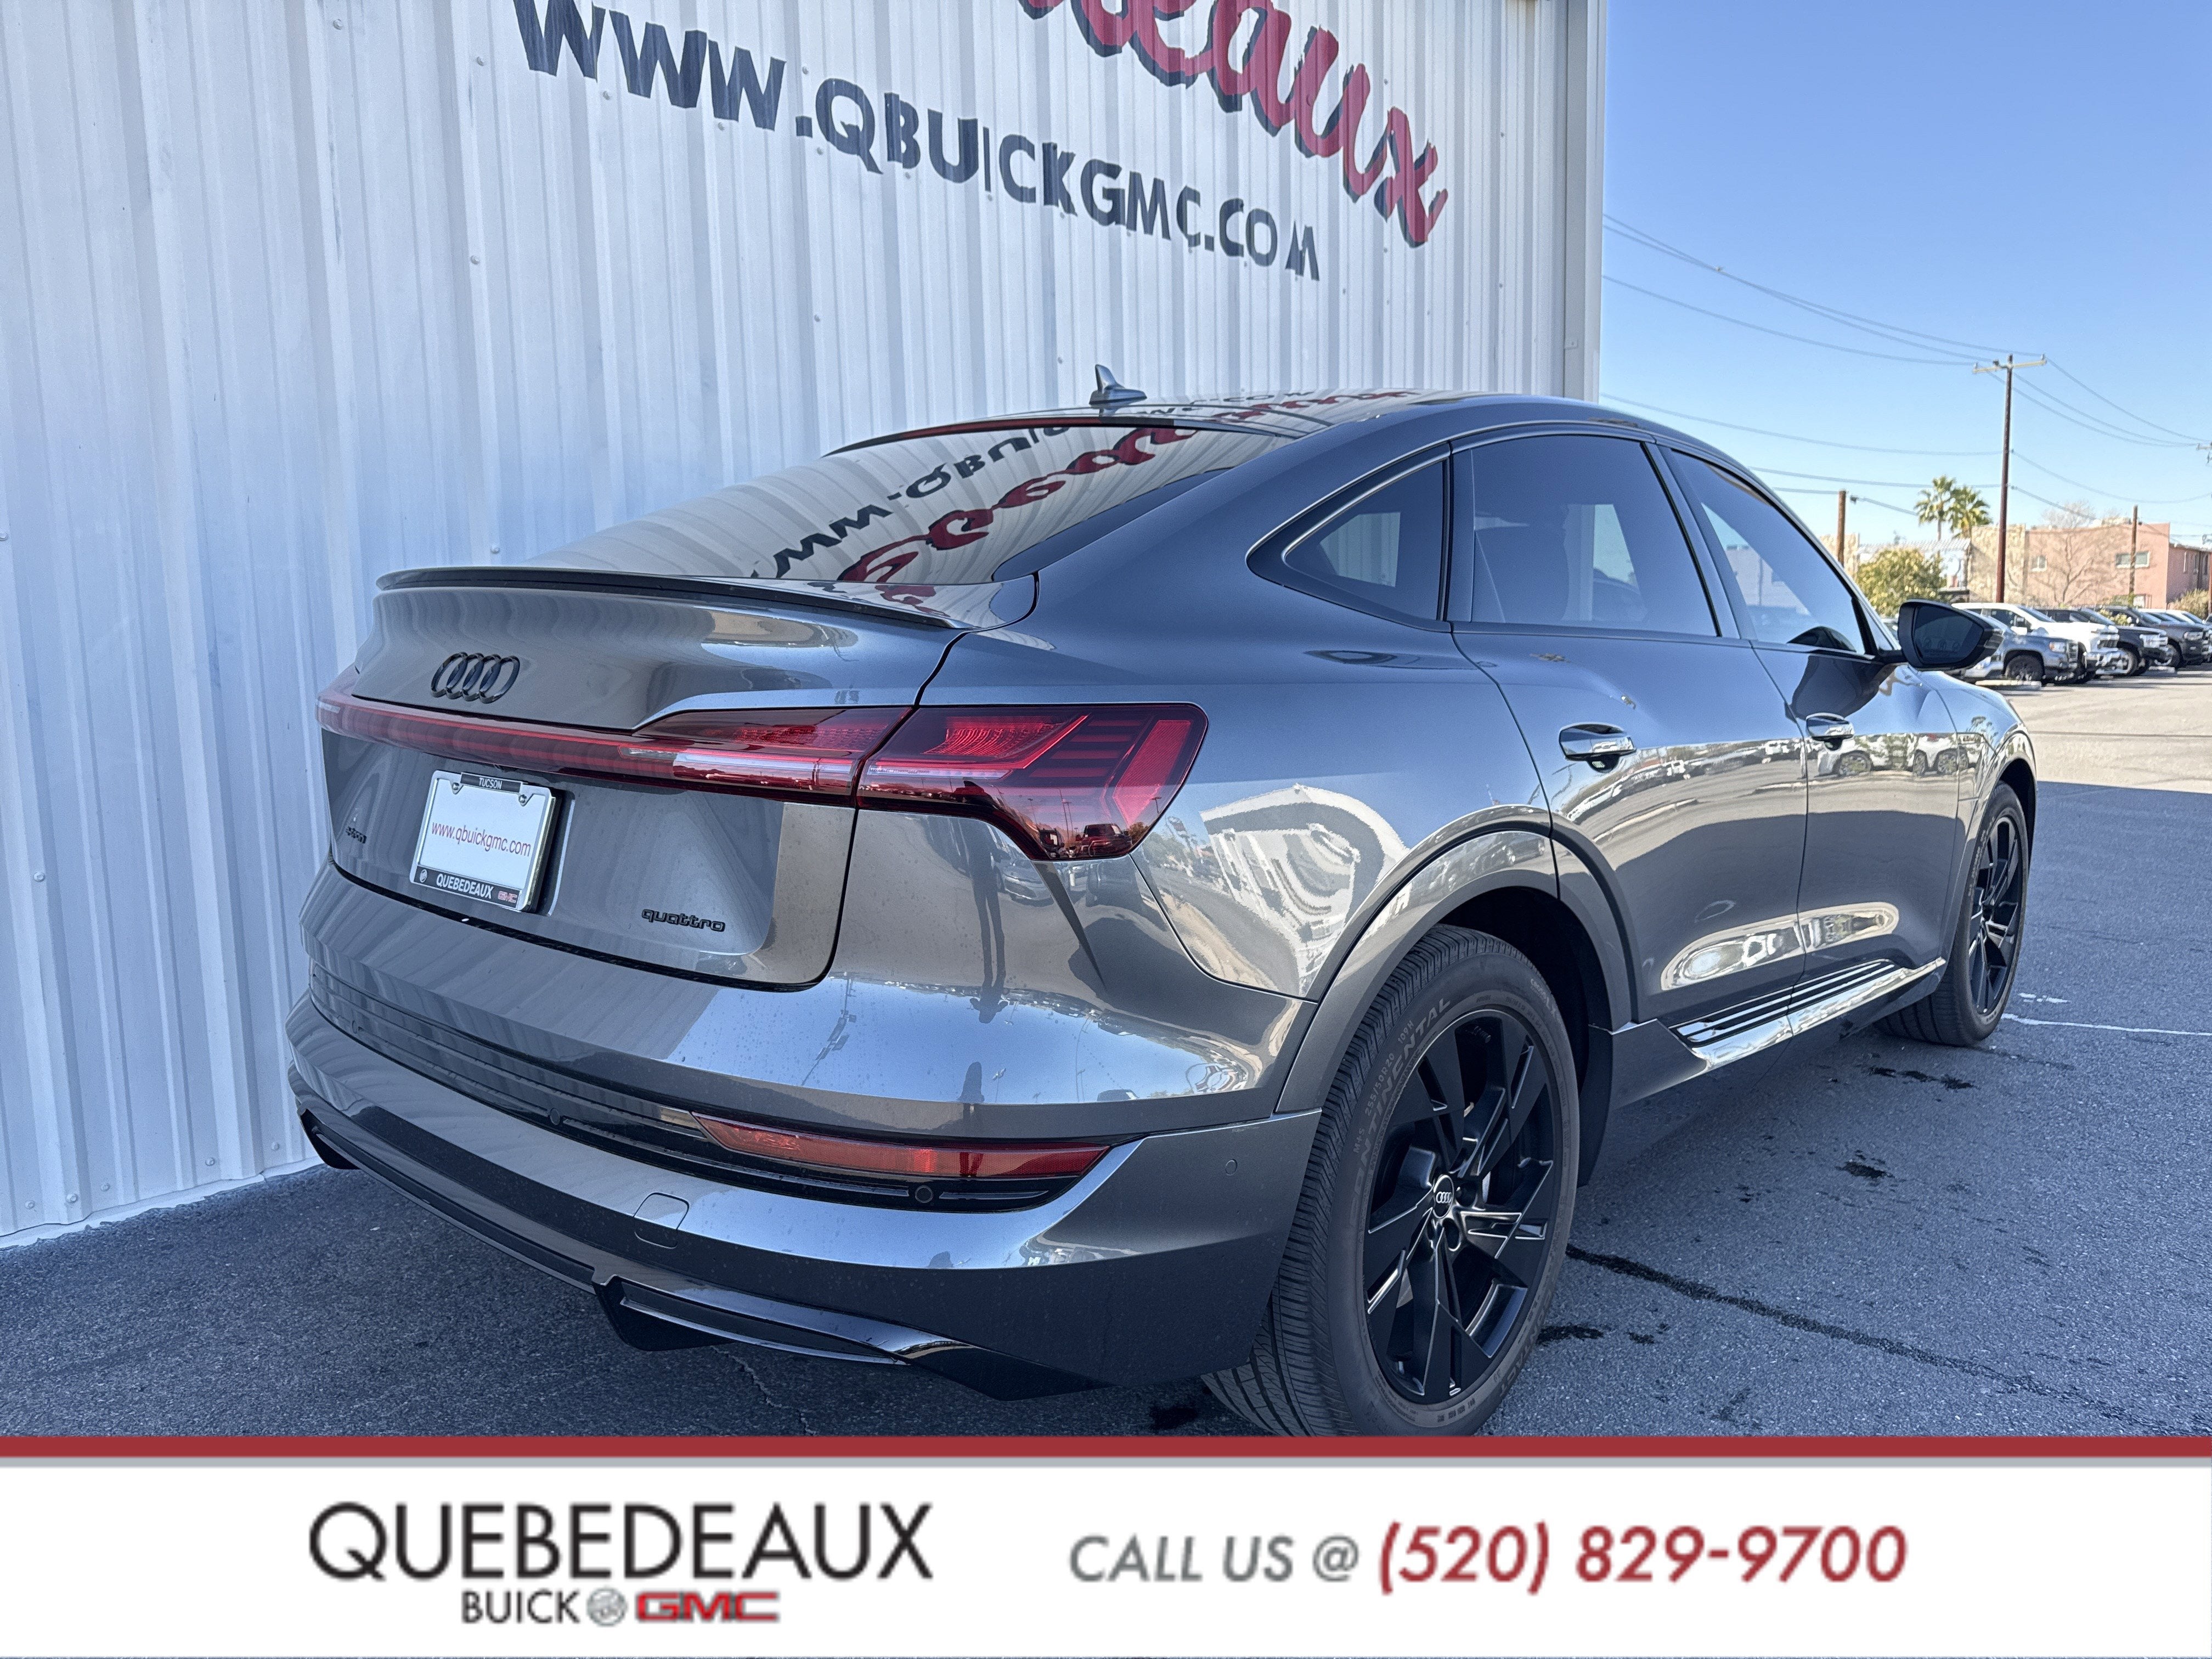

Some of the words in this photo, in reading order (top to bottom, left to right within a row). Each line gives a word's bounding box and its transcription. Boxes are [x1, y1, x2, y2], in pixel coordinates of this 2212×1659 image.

[512, 0, 1319, 281] WWW.QBUICKGMC.COM
[478, 777, 503, 790] TUCSON
[431, 821, 532, 857] www.qbuickgmc.com
[436, 873, 494, 899] QUEBEDEAUX
[498, 890, 518, 904] GMC
[641, 909, 726, 932] quattro
